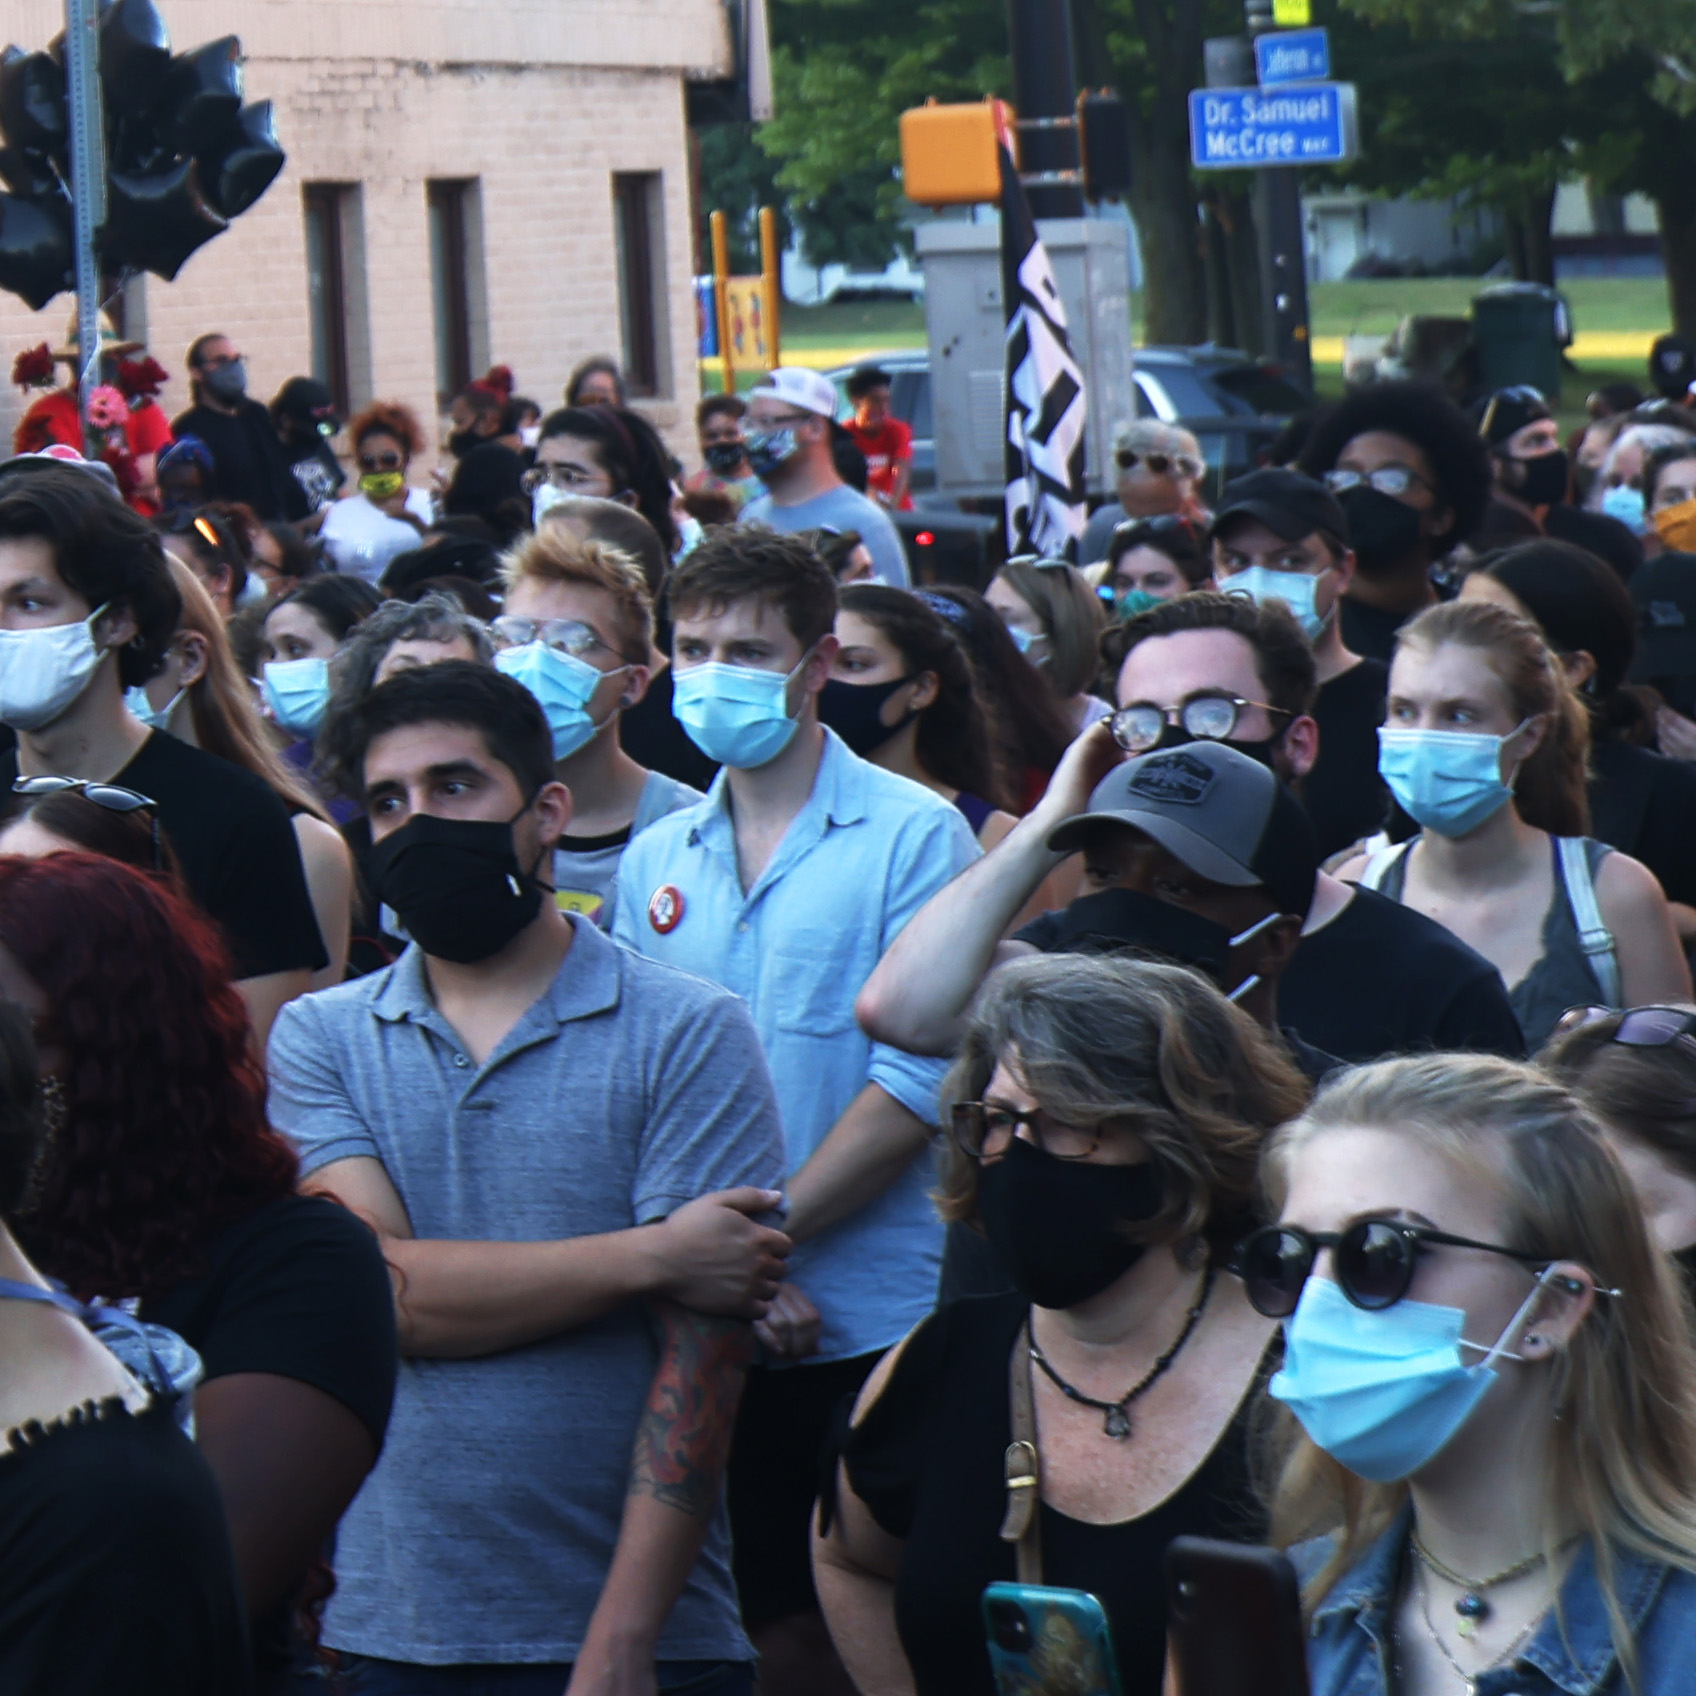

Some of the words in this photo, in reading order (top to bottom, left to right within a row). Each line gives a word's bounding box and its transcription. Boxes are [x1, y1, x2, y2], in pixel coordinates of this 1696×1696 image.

[1204, 96, 1236, 126] Dr.
[1242, 91, 1329, 125] Samuel
[1205, 127, 1296, 156] McCree
